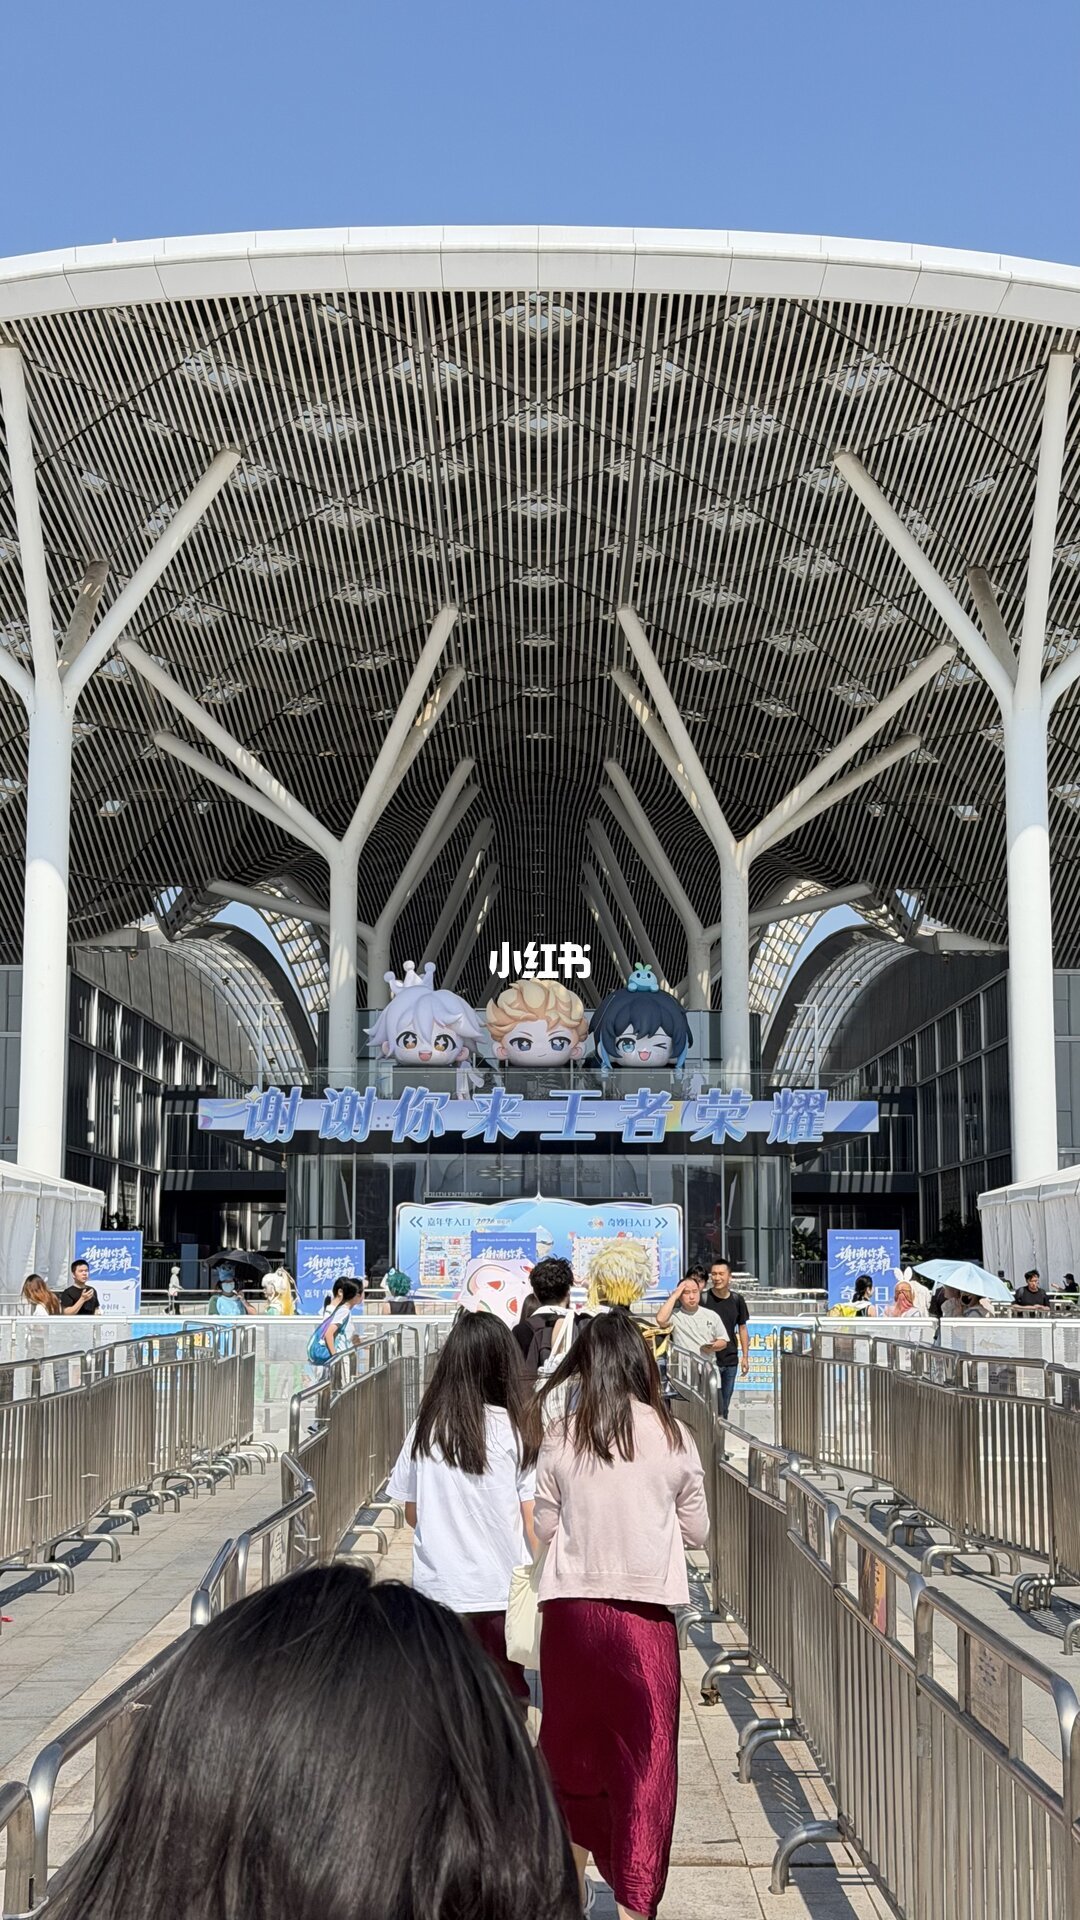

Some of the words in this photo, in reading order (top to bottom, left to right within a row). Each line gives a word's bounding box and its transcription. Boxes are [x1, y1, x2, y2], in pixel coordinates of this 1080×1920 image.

[244, 1086, 828, 1145] 谢谢你来王者荣耀
[427, 1217, 471, 1227] 嘉年华入口
[608, 1218, 651, 1227] 奇妙日入口
[81, 1245, 131, 1260] 谢谢你来
[477, 1246, 526, 1259] 谢谢你来
[835, 1245, 889, 1261] 谢谢你来
[90, 1257, 139, 1274] 王者荣耀
[303, 1254, 354, 1271] 谢谢你来
[845, 1256, 894, 1276] 王者荣耀
